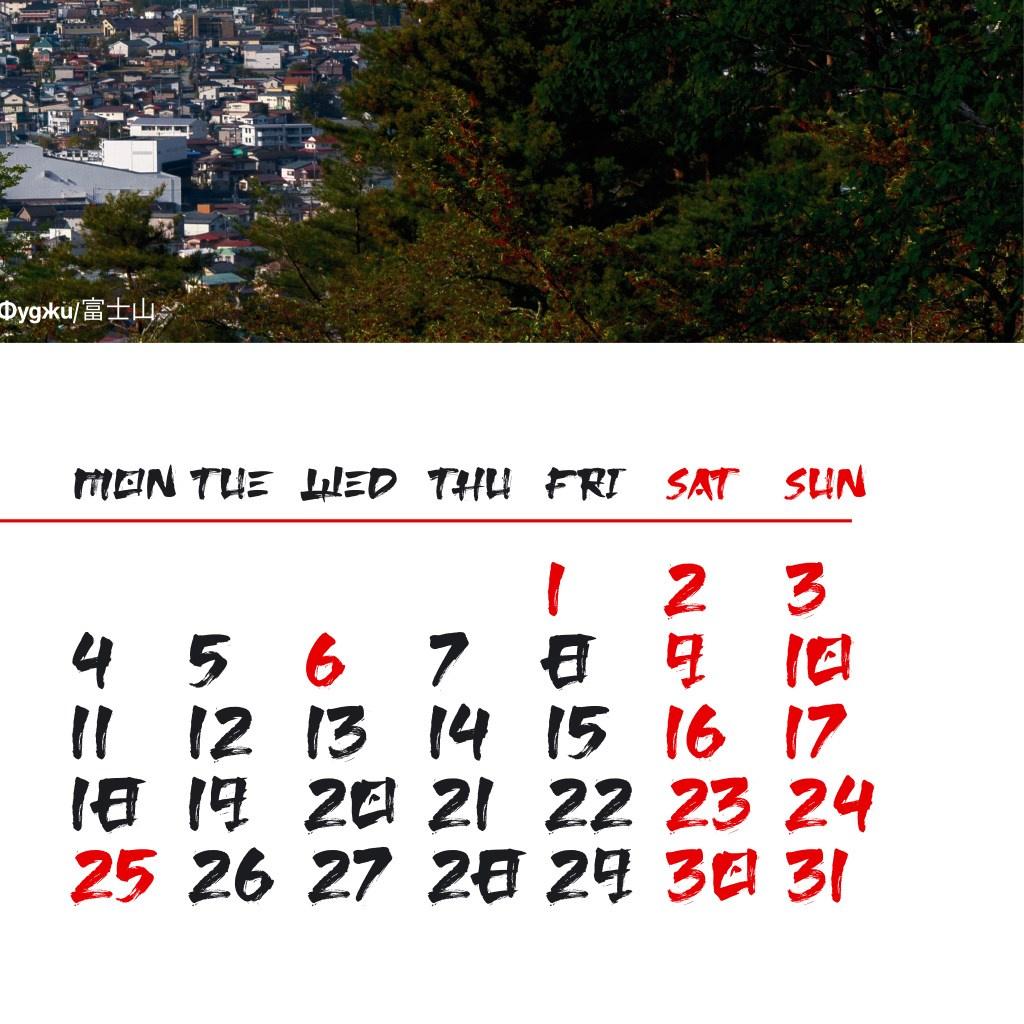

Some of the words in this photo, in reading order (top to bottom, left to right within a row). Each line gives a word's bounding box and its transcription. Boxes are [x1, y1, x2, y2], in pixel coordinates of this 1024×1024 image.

[74, 466, 176, 501] MON
[190, 466, 272, 501] TUE
[300, 466, 397, 502] WED
[428, 466, 511, 501] THU
[545, 467, 626, 501] FRI
[666, 466, 740, 501] SAT
[784, 466, 866, 501] SUN
[548, 562, 565, 616] 1
[664, 563, 707, 617] 2
[786, 562, 825, 616] 3
[72, 632, 113, 689] 4
[190, 634, 230, 688] 5
[306, 633, 345, 687] 6
[430, 632, 469, 686] 7
[541, 634, 595, 689] 8
[667, 633, 704, 689] 9
[786, 634, 852, 688] 10
[72, 705, 112, 759] 11
[190, 705, 252, 761] 12
[307, 705, 366, 759] 13
[430, 704, 490, 760] 14
[548, 705, 609, 759] 15
[666, 704, 726, 759] 16
[786, 704, 847, 759] 17
[72, 777, 144, 832] 18
[189, 776, 248, 832] 19
[304, 777, 396, 833] 20
[428, 777, 493, 833] 21
[545, 778, 632, 833] 22
[666, 777, 750, 833] 23
[785, 775, 874, 832] 24
[71, 849, 157, 904] 25
[189, 848, 274, 904] 26
[308, 847, 392, 903] 27
[428, 848, 527, 905] 28
[545, 848, 631, 904] 29
[666, 848, 757, 902] 30
[786, 849, 848, 903] 31
